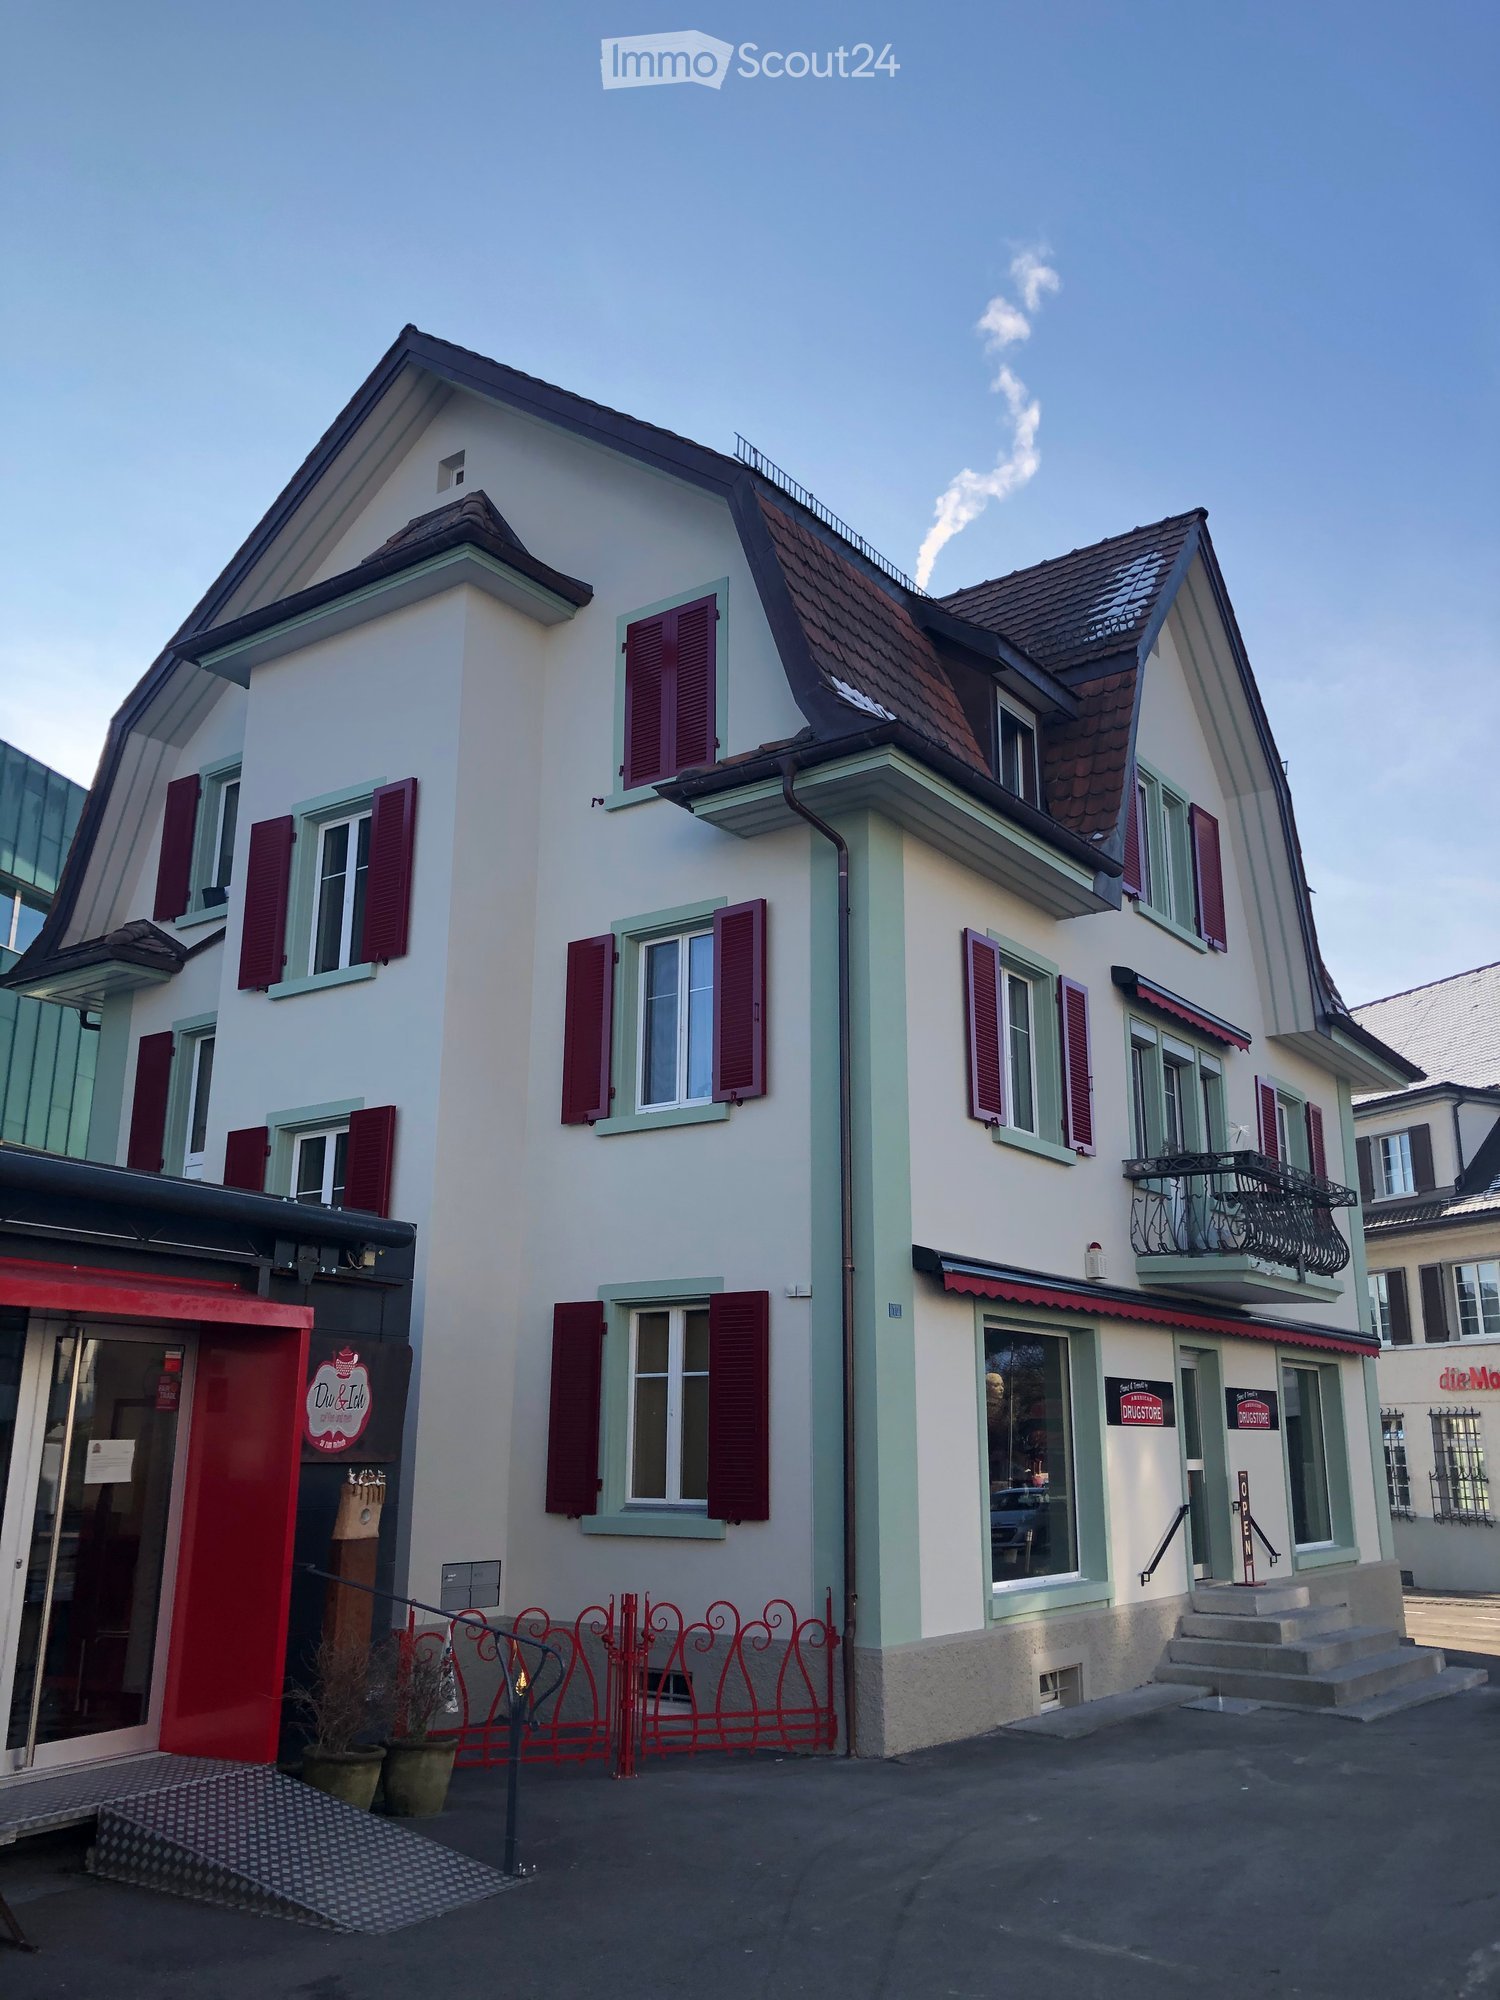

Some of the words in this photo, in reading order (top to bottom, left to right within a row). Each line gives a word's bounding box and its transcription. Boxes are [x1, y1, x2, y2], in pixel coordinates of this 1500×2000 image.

[314, 1382, 335, 1409] Du
[346, 1383, 366, 1409] Ich
[1122, 1404, 1162, 1420] DRUGSTORE
[1239, 1411, 1269, 1424] DRUGSTORE
[1241, 1482, 1252, 1556] OPEN
